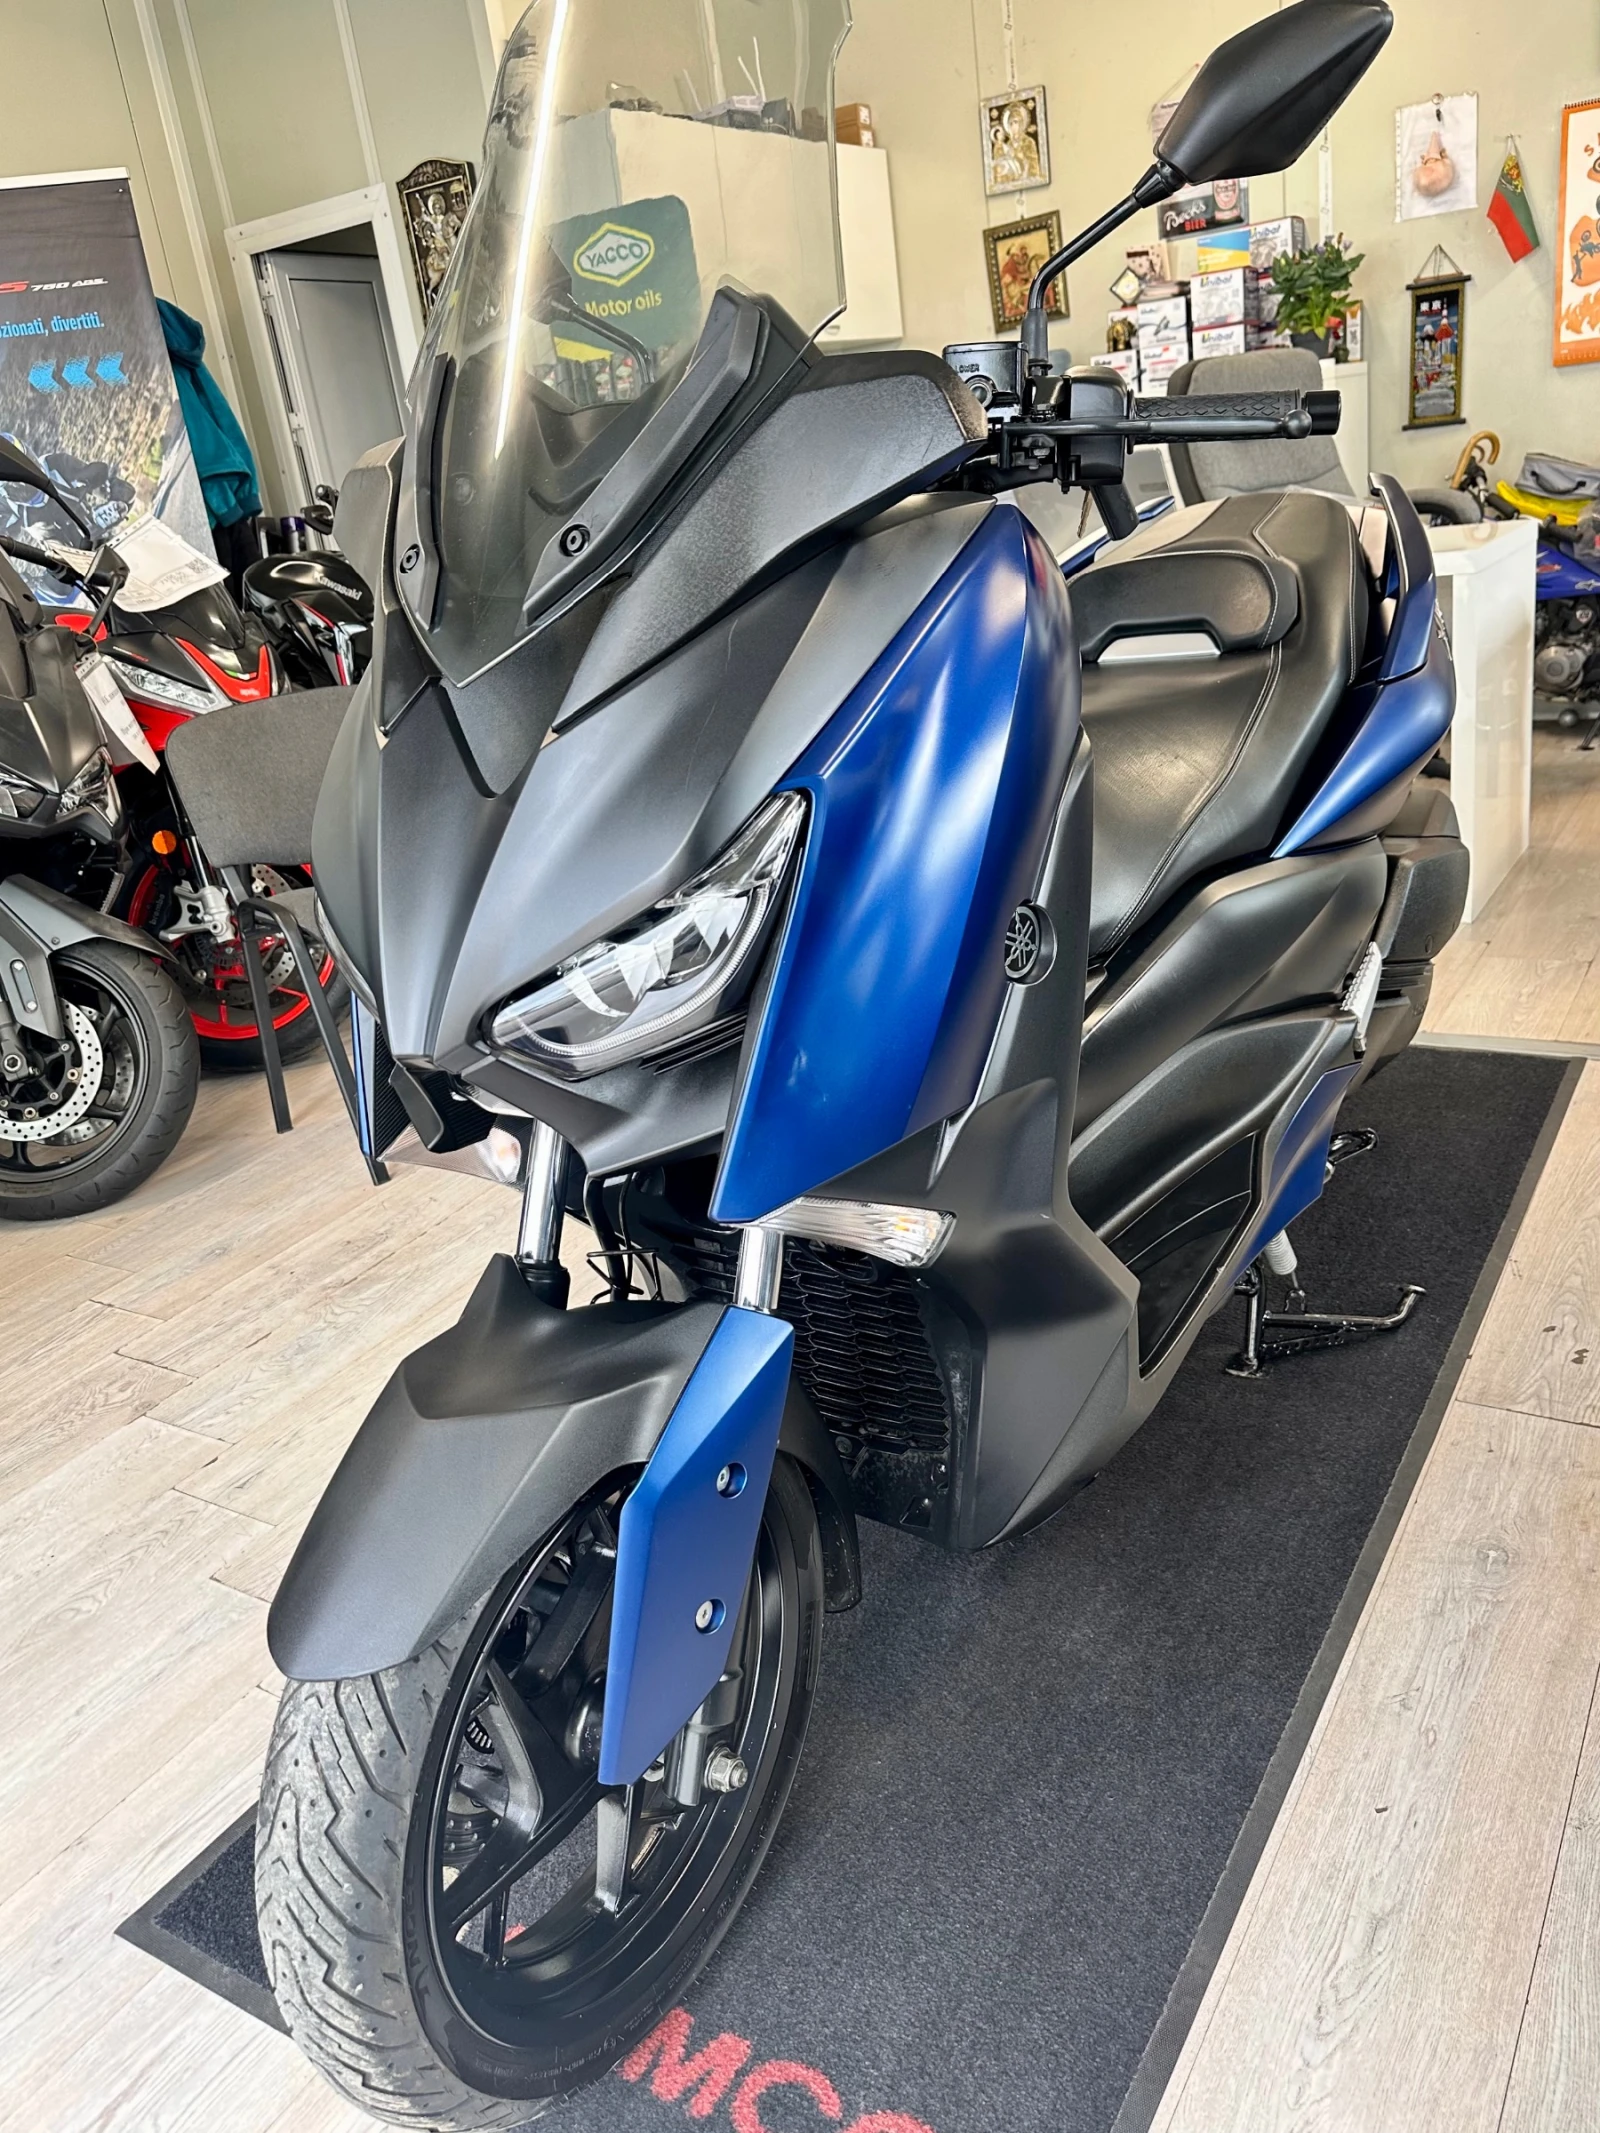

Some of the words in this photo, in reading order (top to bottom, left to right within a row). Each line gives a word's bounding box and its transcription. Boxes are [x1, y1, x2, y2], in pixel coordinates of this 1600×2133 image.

[1184, 217, 1207, 231] BIER
[586, 242, 644, 268] YACCO
[585, 299, 632, 318] Motor
[635, 289, 662, 311] oils
[50, 311, 105, 333] divertiti.
[314, 569, 363, 601] Kawasaki
